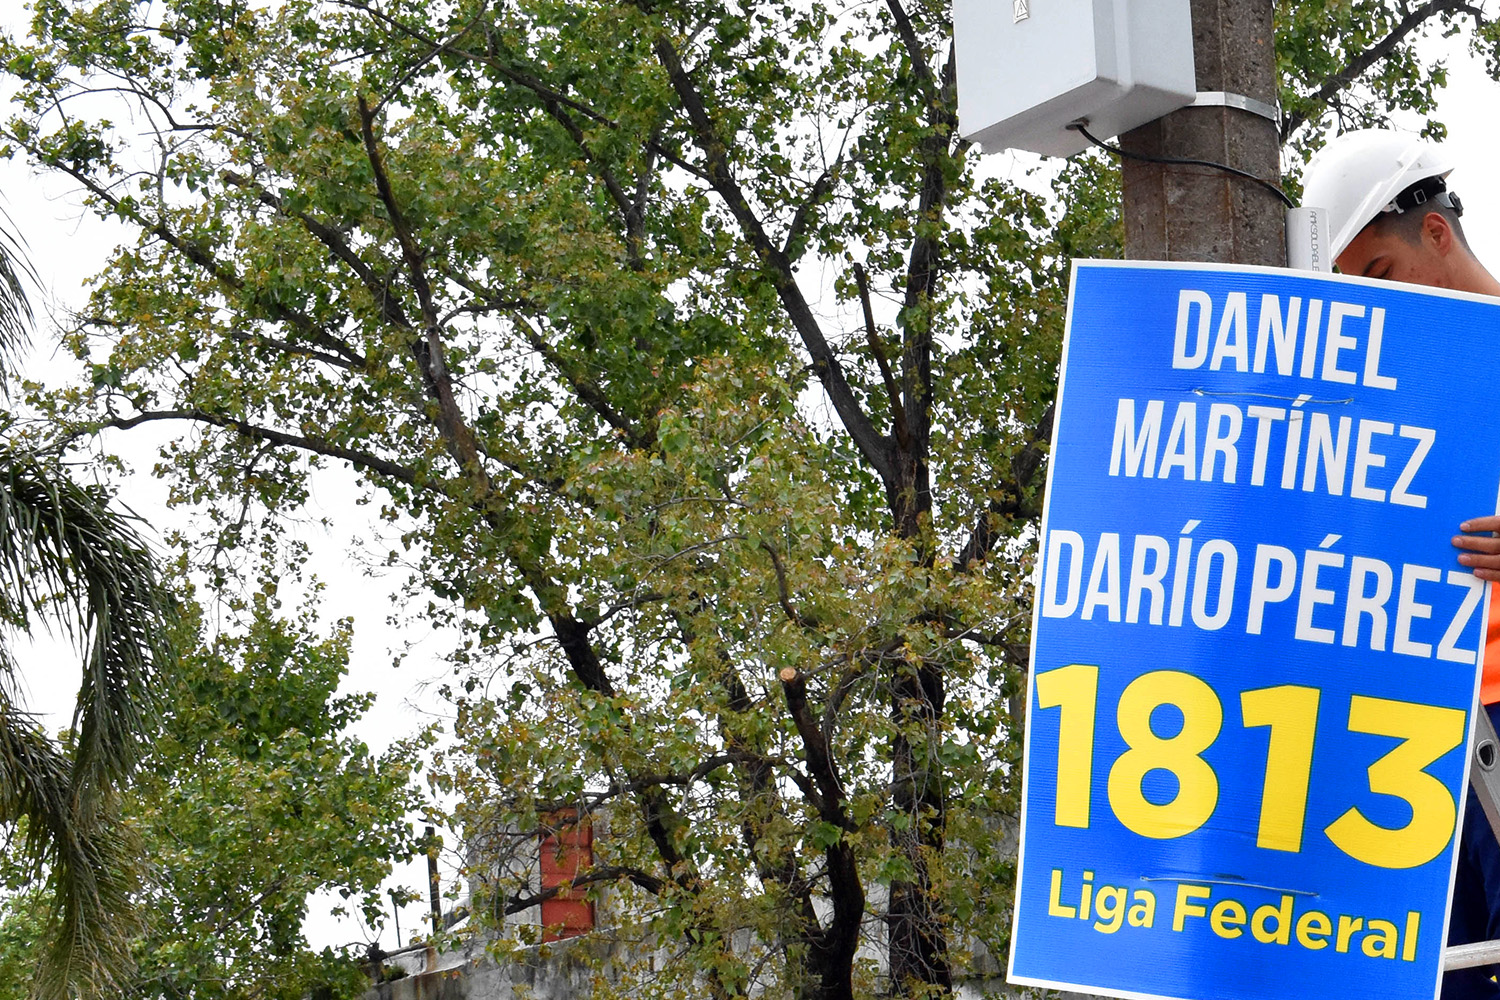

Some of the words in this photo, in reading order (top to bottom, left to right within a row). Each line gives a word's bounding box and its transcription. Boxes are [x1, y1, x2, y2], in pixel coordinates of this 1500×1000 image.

[1172, 289, 1398, 390] DANIEL
[1108, 394, 1436, 509] MARTÍNEZ
[1042, 519, 1239, 631] DARÍO
[1246, 533, 1486, 664] PÉREZ
[1035, 664, 1466, 870] 1813
[1047, 868, 1156, 932] Liga
[1172, 879, 1421, 962] Federal
